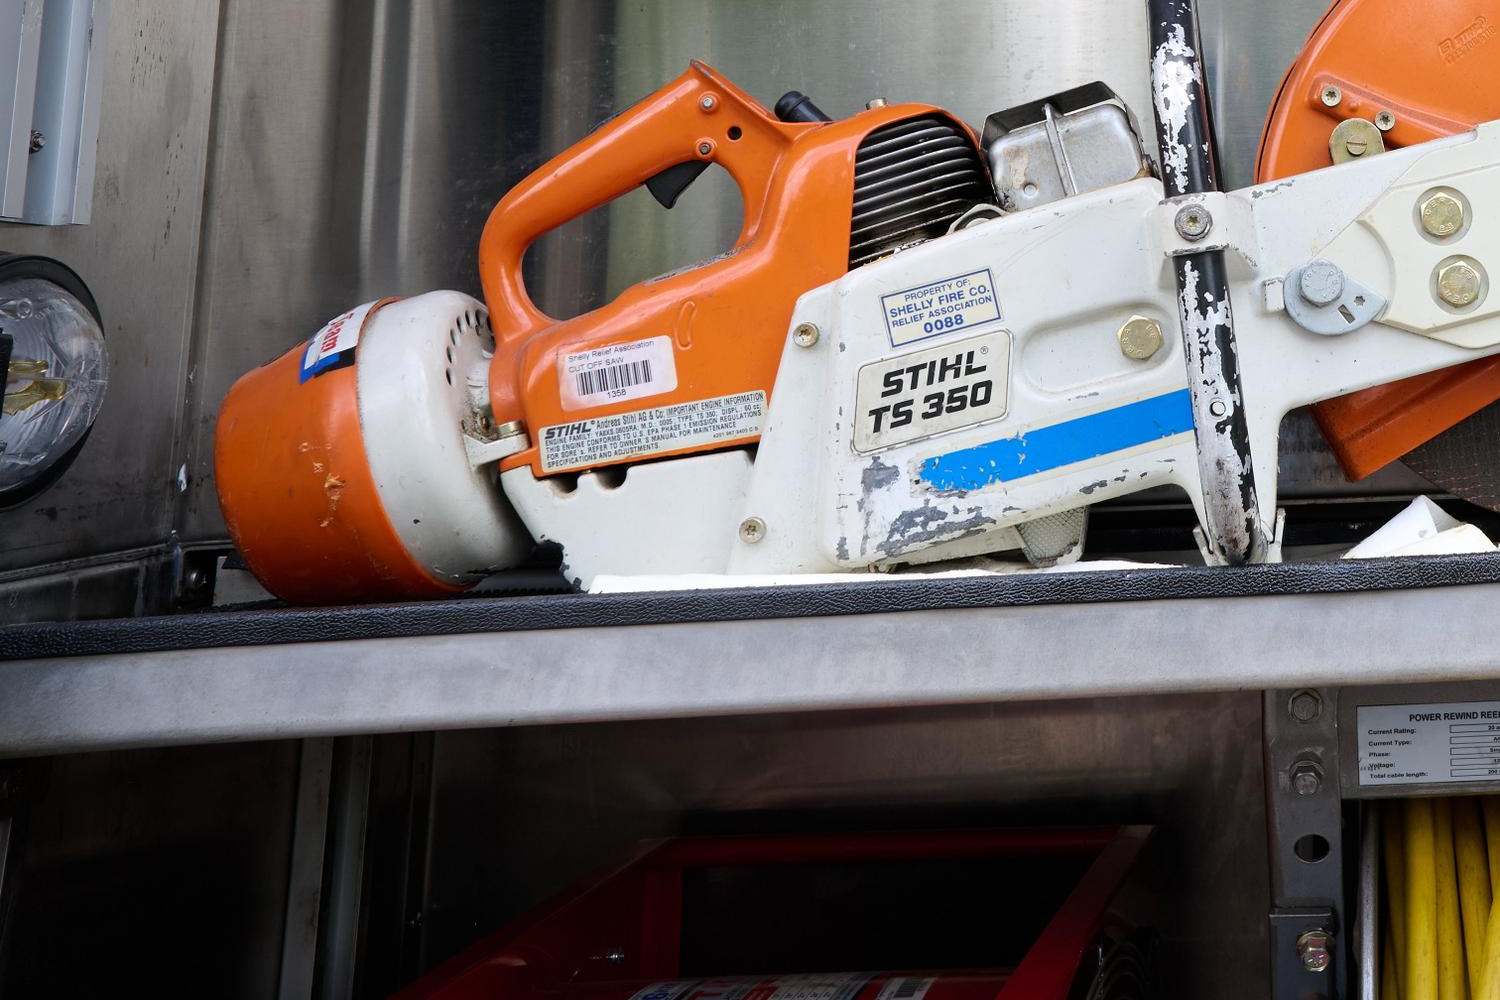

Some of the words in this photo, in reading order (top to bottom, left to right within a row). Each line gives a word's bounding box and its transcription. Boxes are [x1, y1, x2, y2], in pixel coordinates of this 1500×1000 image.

[890, 299, 933, 317] SHELLY
[938, 290, 964, 305] FIRE
[969, 284, 990, 297] CO.
[904, 283, 952, 302] PROPERTY
[956, 279, 970, 290] OF:
[892, 313, 925, 328] RELIEF
[928, 295, 992, 318] ASSOCIATION
[923, 314, 964, 333] 0088
[568, 350, 589, 363] Shelly
[591, 347, 612, 359] Relief
[613, 340, 654, 353] Association
[568, 363, 585, 374] CUT
[587, 360, 603, 370] OFF
[605, 357, 624, 367] SAW
[881, 350, 987, 398] STIHL
[607, 388, 626, 399] 1358
[545, 422, 591, 440] STIHL
[596, 418, 620, 429] Andreas
[622, 414, 636, 425] Stihl
[639, 411, 647, 421] AG
[666, 403, 699, 416] IMPORTANT
[700, 400, 722, 411] ENGINE
[723, 392, 763, 405] INFORMATION
[868, 399, 914, 433] TS
[921, 380, 993, 419] 350
[545, 437, 567, 446] ENGINE
[547, 445, 560, 455] THIS
[562, 440, 585, 451] ENGINE
[587, 434, 620, 446] CONFORMS
[647, 427, 658, 435] EPA
[661, 423, 681, 433] PHASE
[689, 417, 718, 428] EMISSION
[720, 409, 762, 423] REGULATIONS
[547, 452, 559, 461] FOR
[588, 445, 607, 453] REFER
[651, 431, 677, 442] MANUAL
[679, 429, 691, 437] FOR
[693, 421, 736, 434] MAINTENANCE
[547, 454, 597, 468] SPECIFICATIONS
[599, 450, 612, 459] AND
[1409, 713, 1442, 722] POWER
[1444, 711, 1478, 720] REWIND
